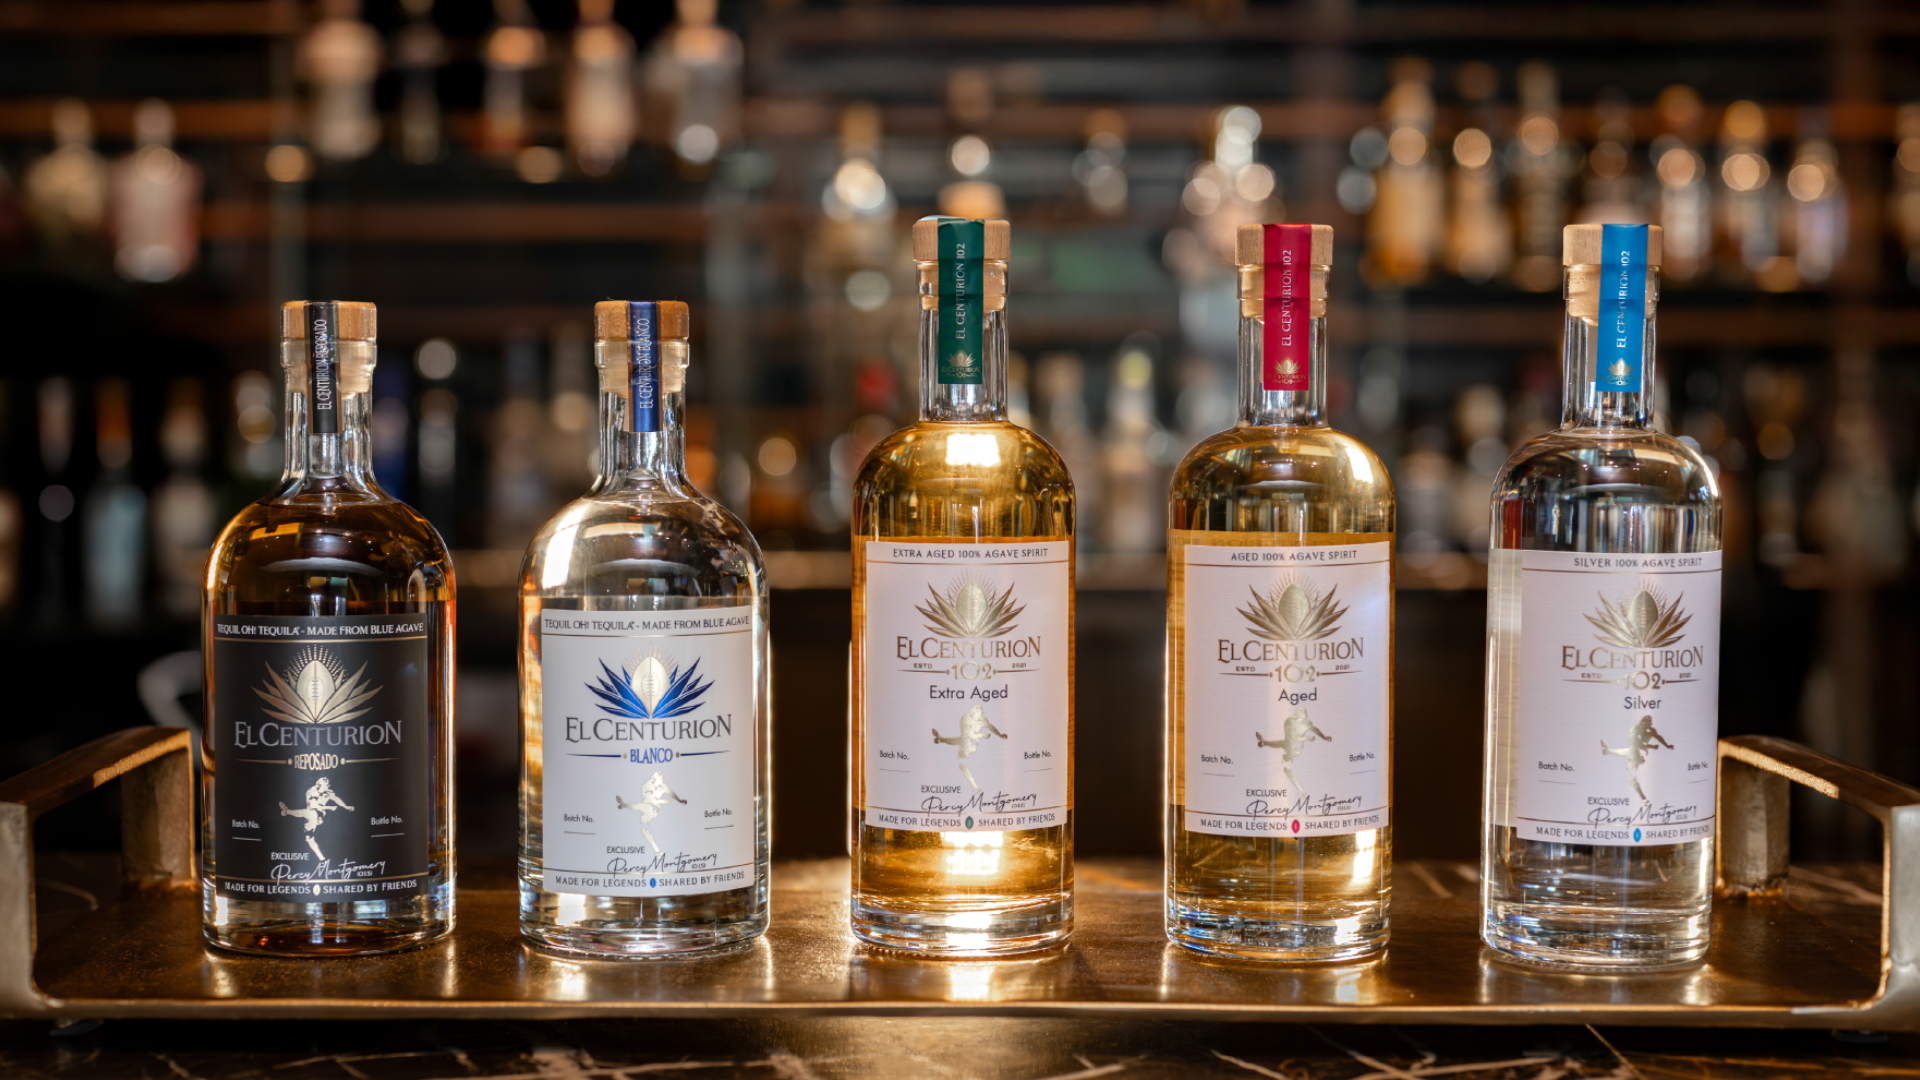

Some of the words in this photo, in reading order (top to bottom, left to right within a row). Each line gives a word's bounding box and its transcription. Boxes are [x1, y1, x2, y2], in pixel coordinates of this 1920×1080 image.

[956, 243, 965, 259] 102
[1283, 250, 1292, 265] 102
[1621, 251, 1630, 265] 102
[956, 263, 965, 325] CENTURION
[1282, 269, 1292, 332] CENTURION
[1617, 270, 1628, 333] CENTURION
[314, 319, 329, 358] REPOSADO
[638, 318, 652, 351] BLANCO
[956, 328, 965, 339] EL
[1282, 335, 1292, 346] EL
[1617, 336, 1627, 348] EL
[316, 359, 332, 400] CENTURION
[639, 356, 653, 399] CENTURION
[893, 549, 922, 558] EXTRA
[926, 549, 954, 559] AGED
[958, 549, 980, 558] 100%
[985, 549, 1018, 558] AGAVE
[1021, 548, 1048, 557] SPIRIT
[1231, 552, 1258, 561] AGED
[1262, 552, 1285, 561] 100%
[1289, 552, 1325, 561] AGAVE
[1328, 550, 1357, 560] SPIRIT
[1574, 558, 1611, 567] SILVER
[1642, 558, 1675, 567] AGAVE
[1678, 557, 1702, 566] SPIRIT
[217, 624, 240, 634] TEQUIL
[241, 625, 256, 634] OH!
[307, 626, 338, 635] MADE
[340, 625, 368, 635] FROM
[371, 624, 394, 634] BLUE
[396, 623, 424, 633] AGAVE
[545, 619, 571, 629] TEQUIL
[574, 620, 589, 629] OH!
[642, 620, 672, 630] MADE
[675, 620, 700, 629] FROM
[703, 618, 724, 628] BLUE
[726, 616, 749, 626] AGAVE
[952, 661, 992, 680] 102
[1275, 664, 1316, 682] 102
[1622, 671, 1662, 690] 102
[930, 685, 964, 699] Extra
[970, 685, 1008, 702] Aged
[1278, 687, 1317, 705] Aged
[1624, 696, 1662, 709] Silver
[294, 753, 339, 770] REPOSADO
[630, 748, 673, 764] BLANCO
[880, 750, 895, 759] Batch
[897, 752, 909, 760] No.
[1024, 751, 1040, 760] Bottle
[1201, 754, 1218, 764] Batch
[1220, 756, 1233, 764] No.
[1349, 753, 1365, 762] Bottle
[1538, 762, 1557, 771] Batch
[1559, 762, 1574, 772] No.
[1688, 762, 1700, 770] Bottle
[921, 785, 961, 794] EXCLUSIVE
[1246, 789, 1287, 797] EXCLUSIVE
[921, 795, 967, 816] Percy
[966, 791, 1037, 812] Montgomery
[1246, 800, 1290, 820] Percy
[1288, 793, 1362, 815] Montgomery
[1588, 798, 1630, 806] EXCLUSIVE
[564, 814, 580, 822] Batch
[704, 809, 722, 818] Bottle
[879, 814, 898, 824] MADE
[901, 816, 918, 825] FOR
[921, 817, 961, 827] LEGENDS
[978, 816, 1013, 827] SHARED
[1016, 816, 1026, 825] BY
[1028, 813, 1055, 823] FRIENDS
[1588, 808, 1632, 829] Percy
[1630, 802, 1697, 824] Montgomery
[232, 819, 247, 828] Batch
[370, 817, 390, 826] Bottle
[1200, 819, 1221, 829] MADE
[1225, 820, 1242, 829] FOR
[1246, 820, 1288, 830] LEGENDS
[1304, 819, 1340, 829] SHARED
[1342, 819, 1352, 827] BY
[1354, 815, 1379, 826] FRIENDS
[1536, 827, 1561, 837] MADE
[1564, 829, 1583, 838] FOR
[1586, 829, 1629, 839] LEGENDS
[1646, 828, 1676, 838] SHARED
[1680, 828, 1688, 836] BY
[1690, 825, 1710, 836] FRIENDS
[606, 846, 646, 854] EXCLUSIVE
[607, 856, 650, 876] Percy
[646, 851, 718, 873] Montgomery
[270, 863, 312, 886] Percy
[308, 858, 386, 880] Montgomery
[555, 876, 578, 886] MADE
[581, 878, 600, 887] FOR
[603, 878, 647, 888] LEGENDS
[659, 876, 698, 887] SHARED
[700, 875, 712, 884] BY
[714, 871, 745, 883] FRIENDS
[225, 882, 246, 892] MADE
[248, 884, 265, 893] FOR
[267, 885, 311, 894] LEGENDS
[322, 884, 364, 894] SHARED
[366, 883, 378, 892] BY
[382, 880, 417, 890] FRIENDS
